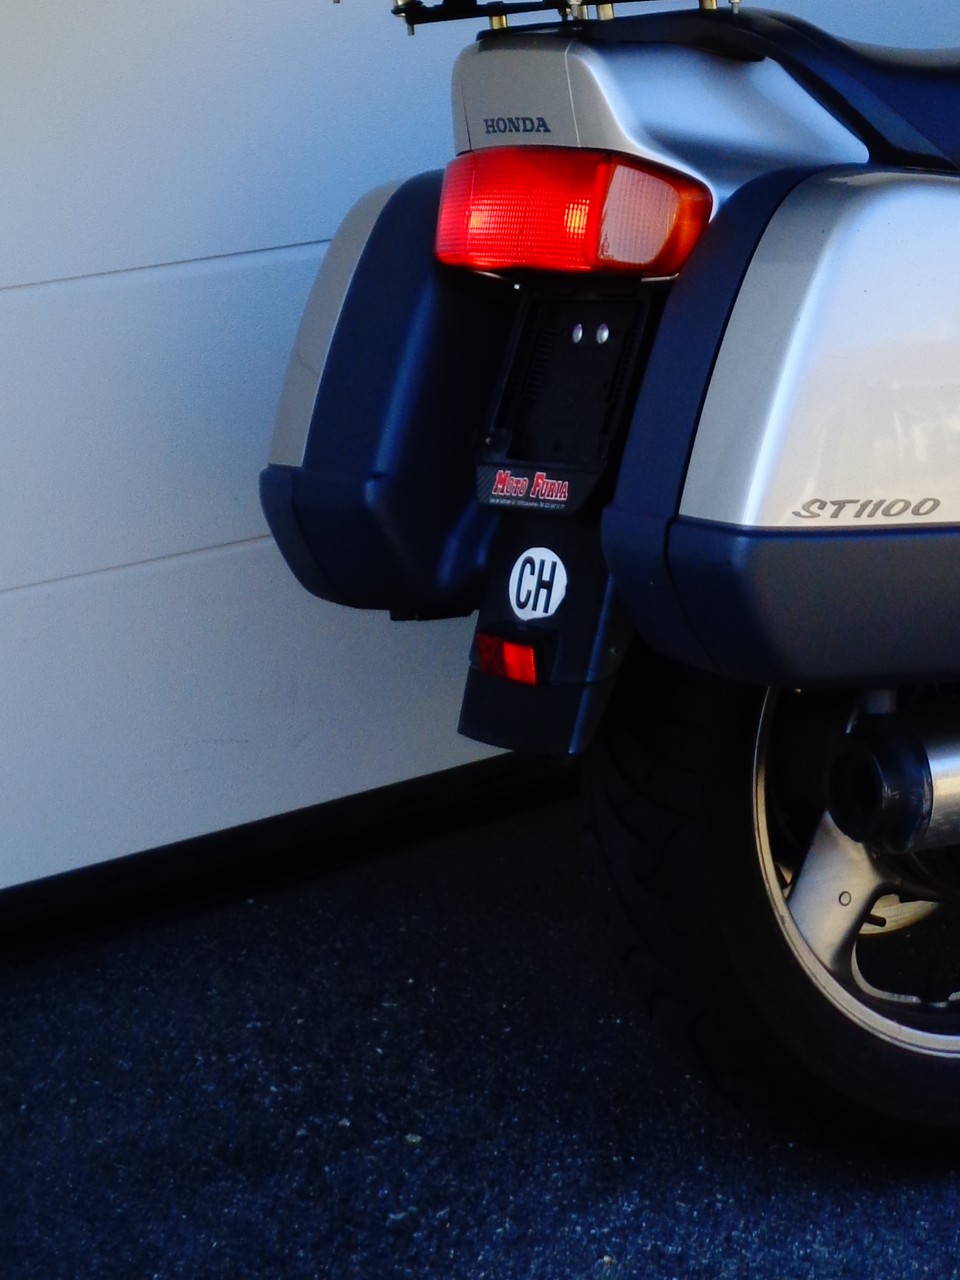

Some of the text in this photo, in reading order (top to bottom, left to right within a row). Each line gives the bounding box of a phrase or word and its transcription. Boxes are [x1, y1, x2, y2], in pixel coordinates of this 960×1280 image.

[483, 116, 552, 135] HONDA
[791, 497, 941, 519] ST1100
[515, 555, 558, 615] CH
